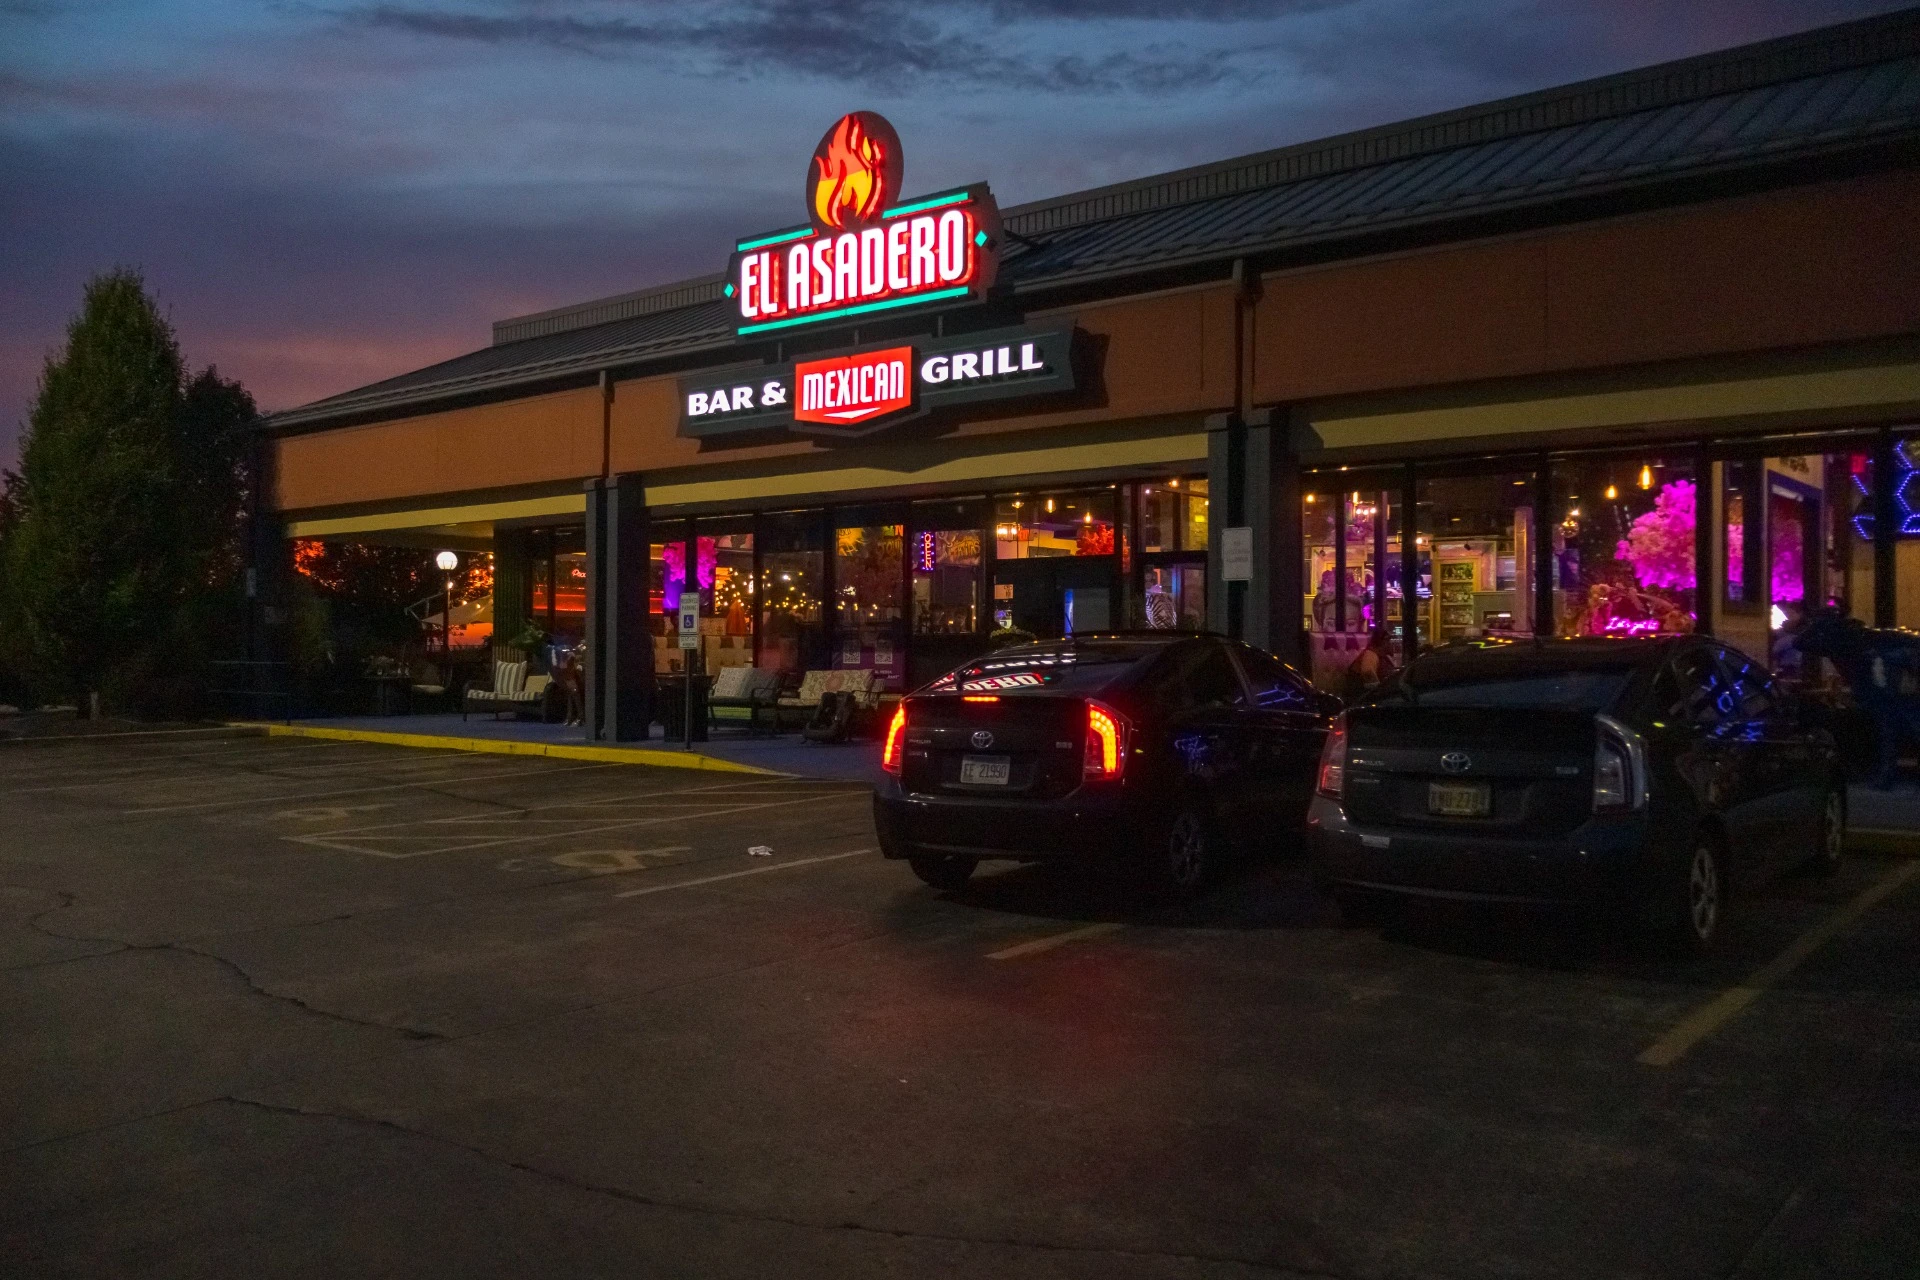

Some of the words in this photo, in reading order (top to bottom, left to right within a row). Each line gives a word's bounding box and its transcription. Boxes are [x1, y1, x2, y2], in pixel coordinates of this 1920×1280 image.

[741, 253, 778, 318] EL
[787, 209, 965, 309] ASADERO
[688, 385, 754, 417] BAR
[761, 381, 786, 406] &
[802, 360, 905, 411] MEXICAN
[921, 342, 1043, 384] GRILL
[924, 533, 932, 569] OPEN
